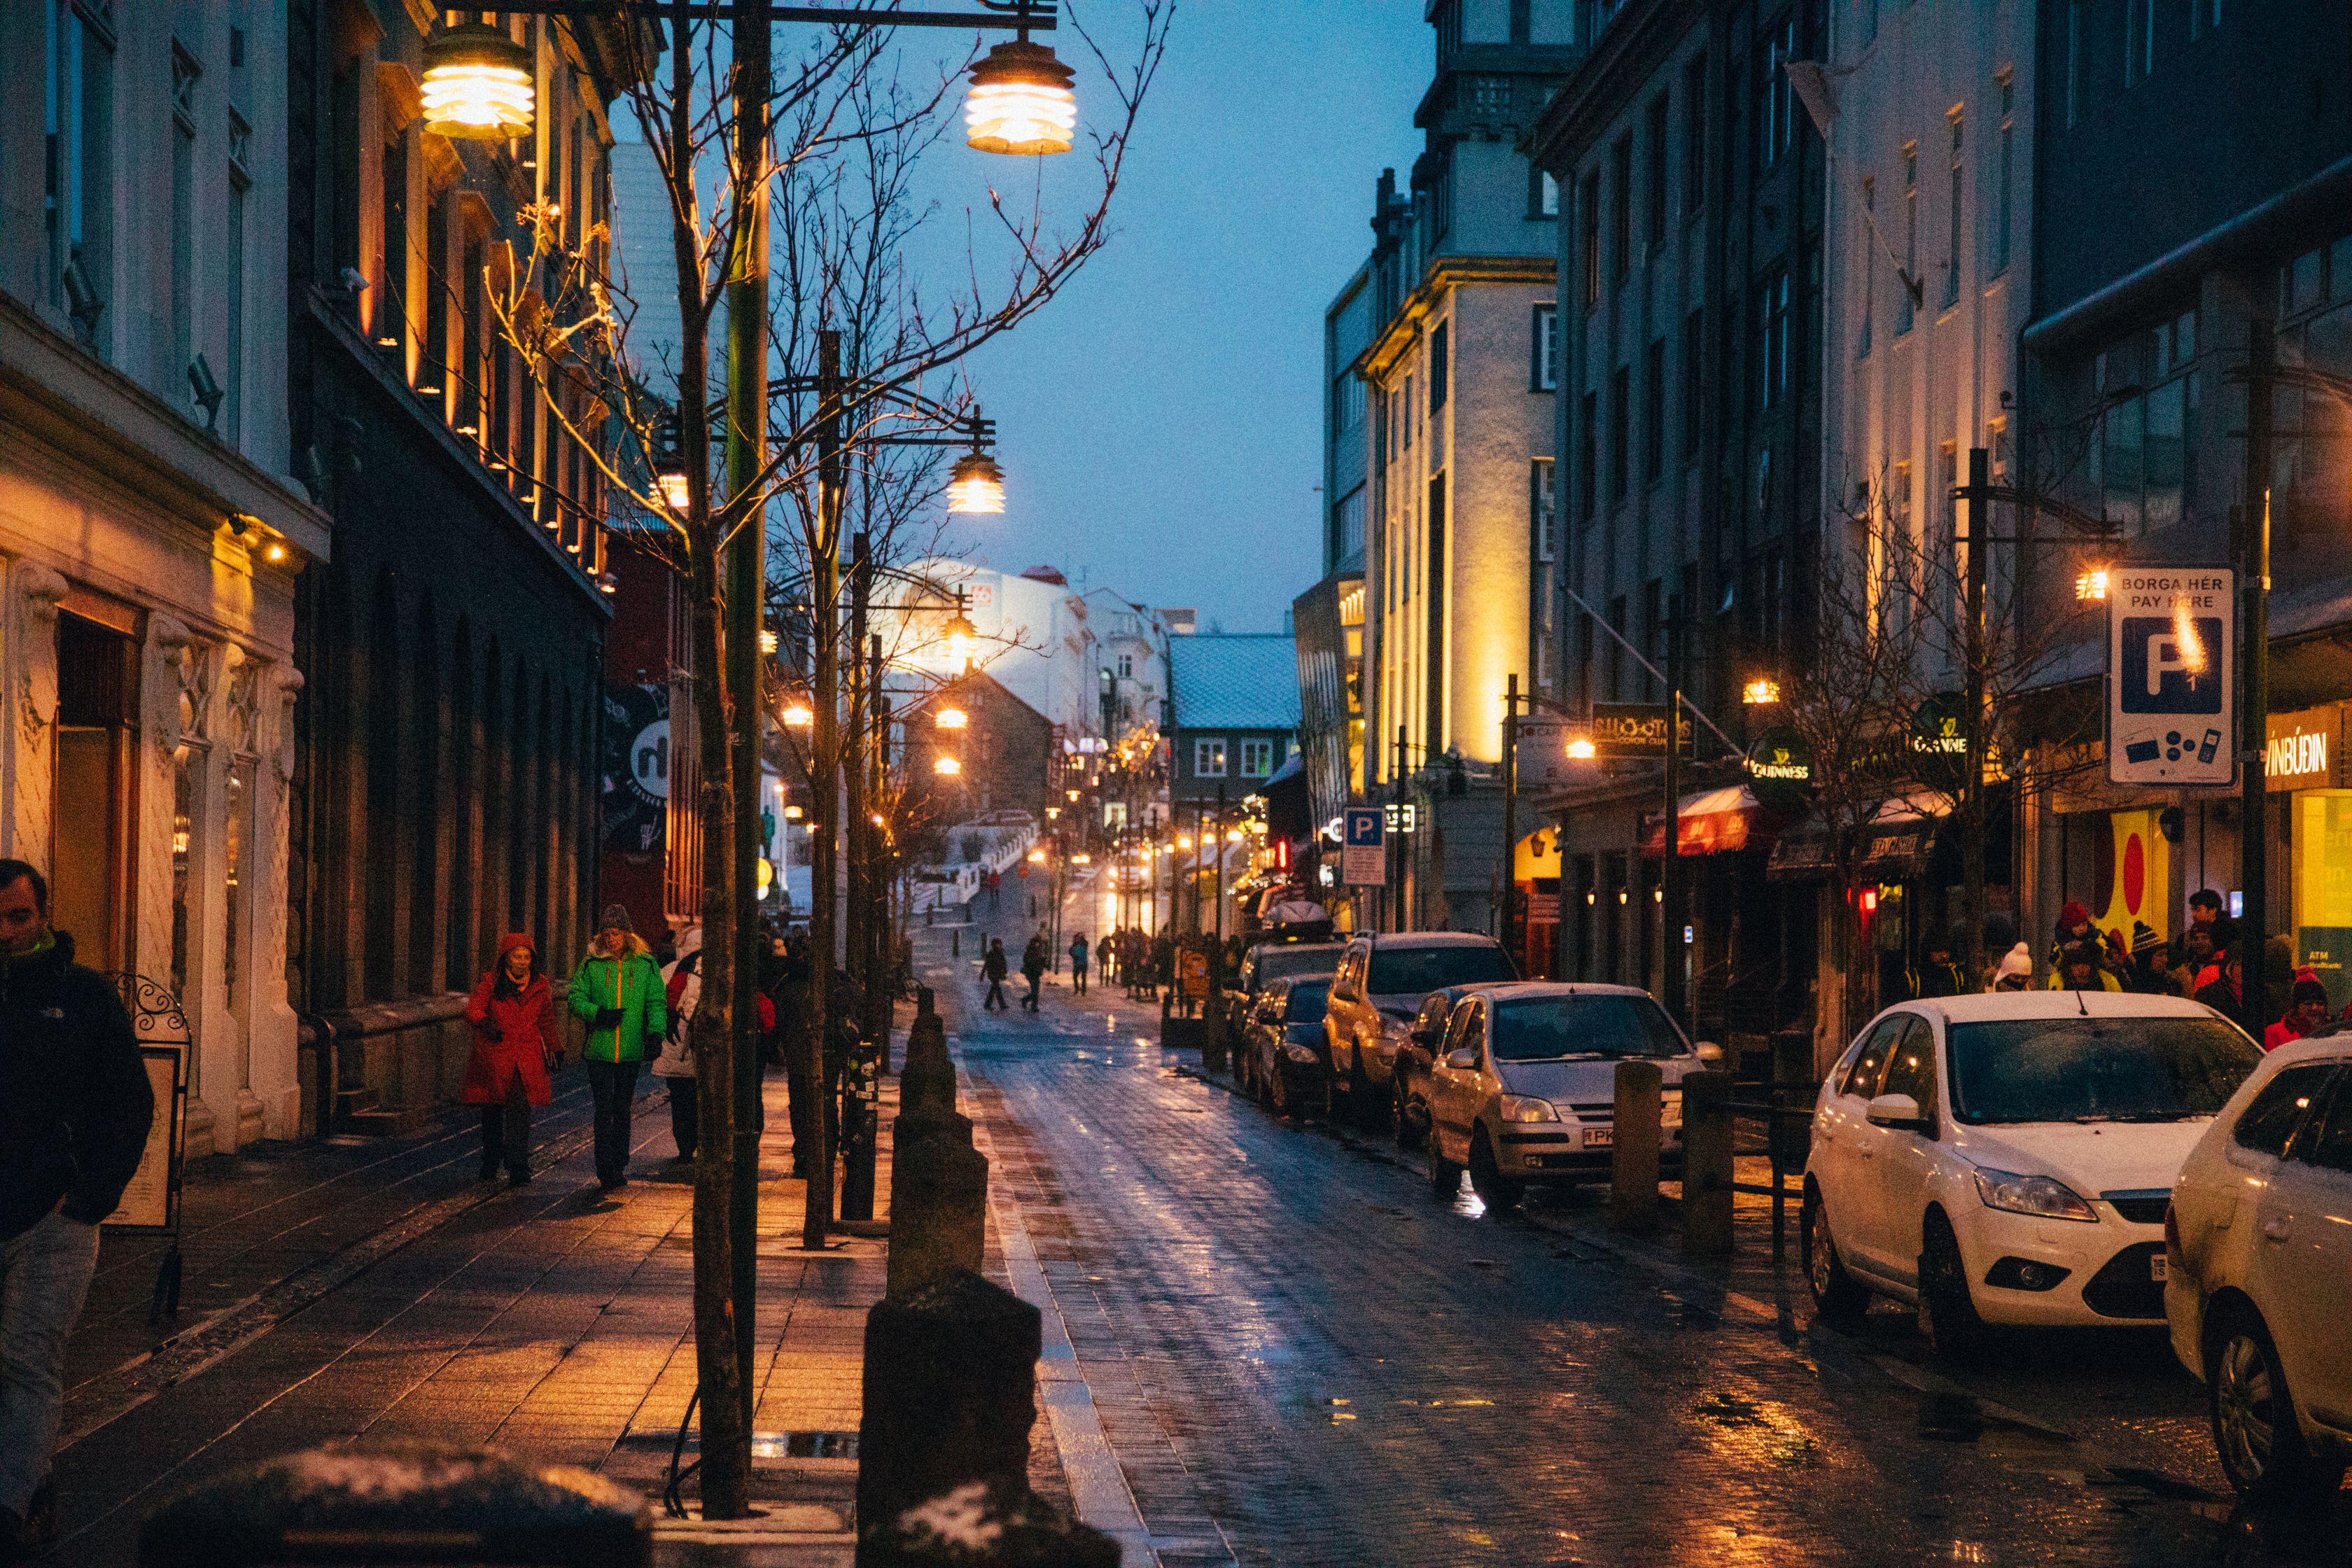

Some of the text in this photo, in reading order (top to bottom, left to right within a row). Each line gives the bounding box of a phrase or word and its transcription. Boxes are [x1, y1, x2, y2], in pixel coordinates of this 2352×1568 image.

[2122, 576, 2223, 590] BORGA HÉR
[2132, 596, 2213, 608] PAY HRE
[1595, 716, 1691, 738] SHOOTS
[1753, 763, 1809, 779] GUINNESS
[1355, 817, 1374, 839] P
[2309, 951, 2329, 960] ATM
